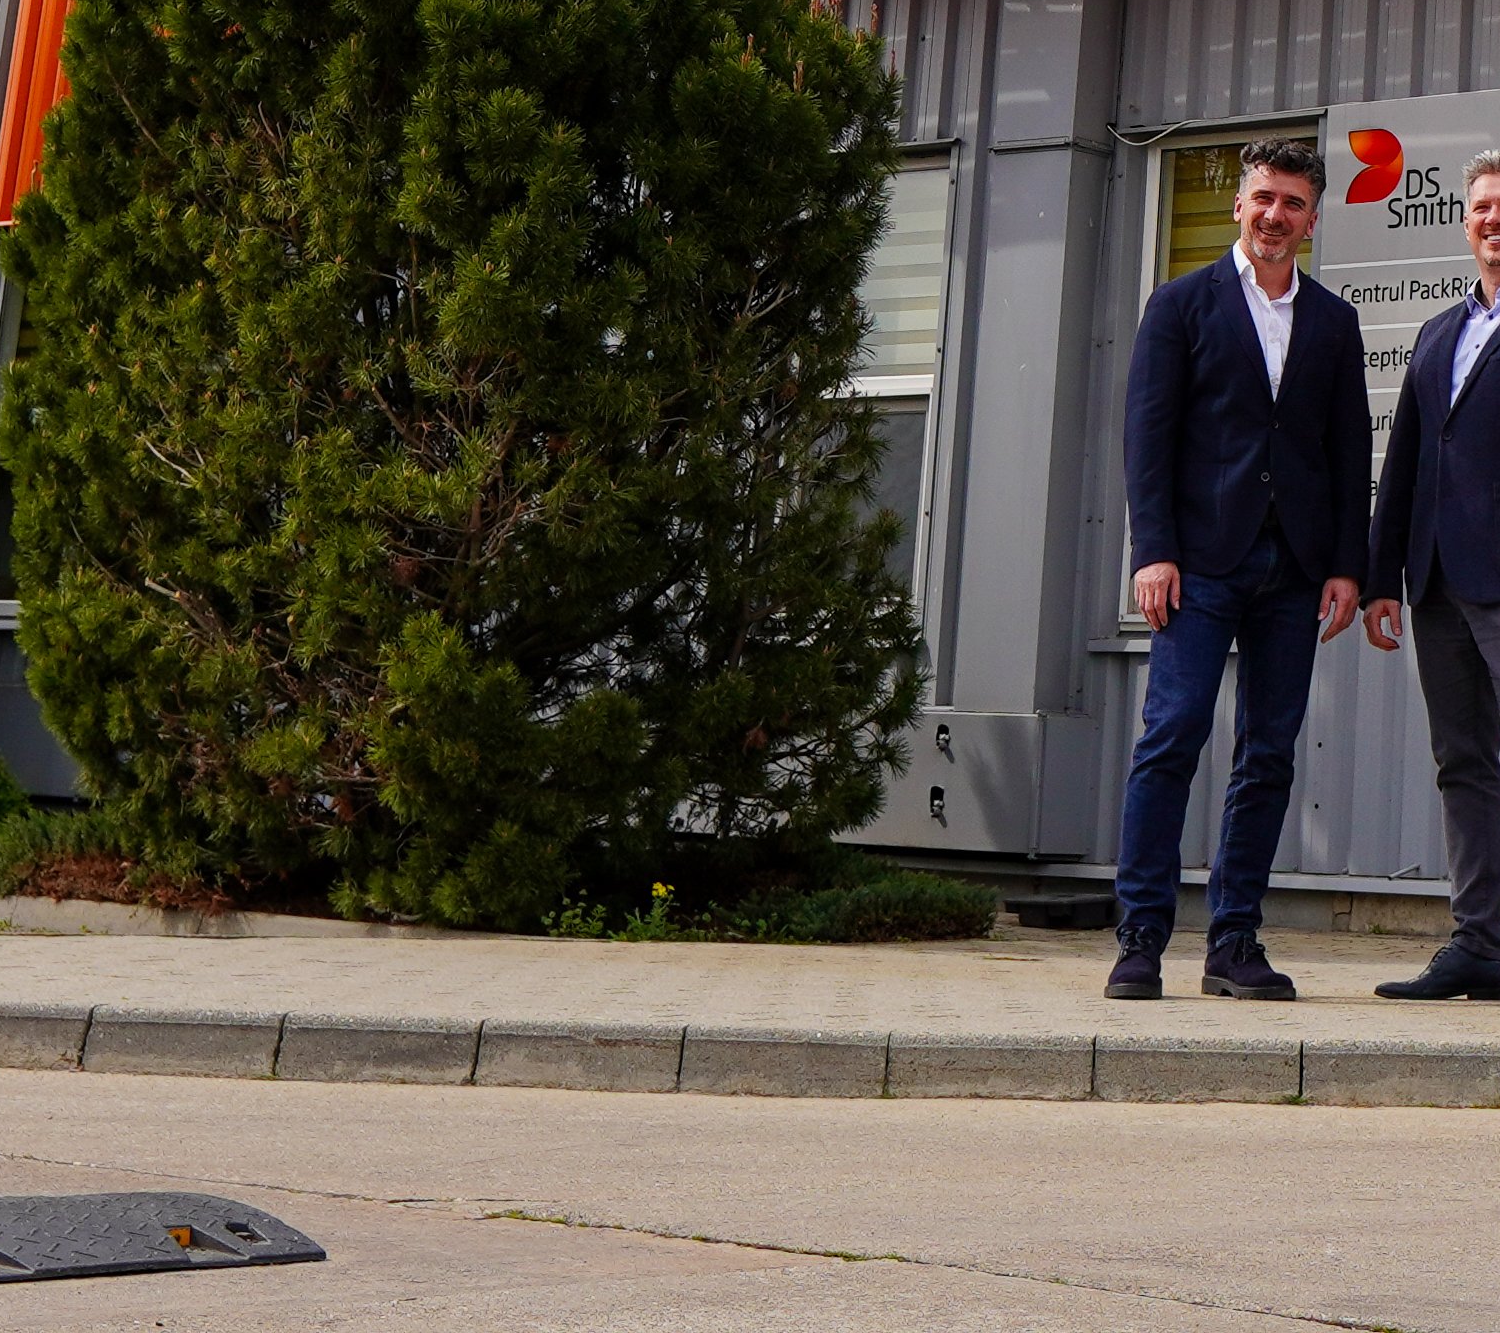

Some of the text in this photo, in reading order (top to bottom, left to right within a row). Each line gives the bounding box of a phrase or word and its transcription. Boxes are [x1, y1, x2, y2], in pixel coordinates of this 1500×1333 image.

[1405, 166, 1440, 199] DS
[1387, 192, 1464, 228] Smith
[1341, 280, 1404, 304] Centrul
